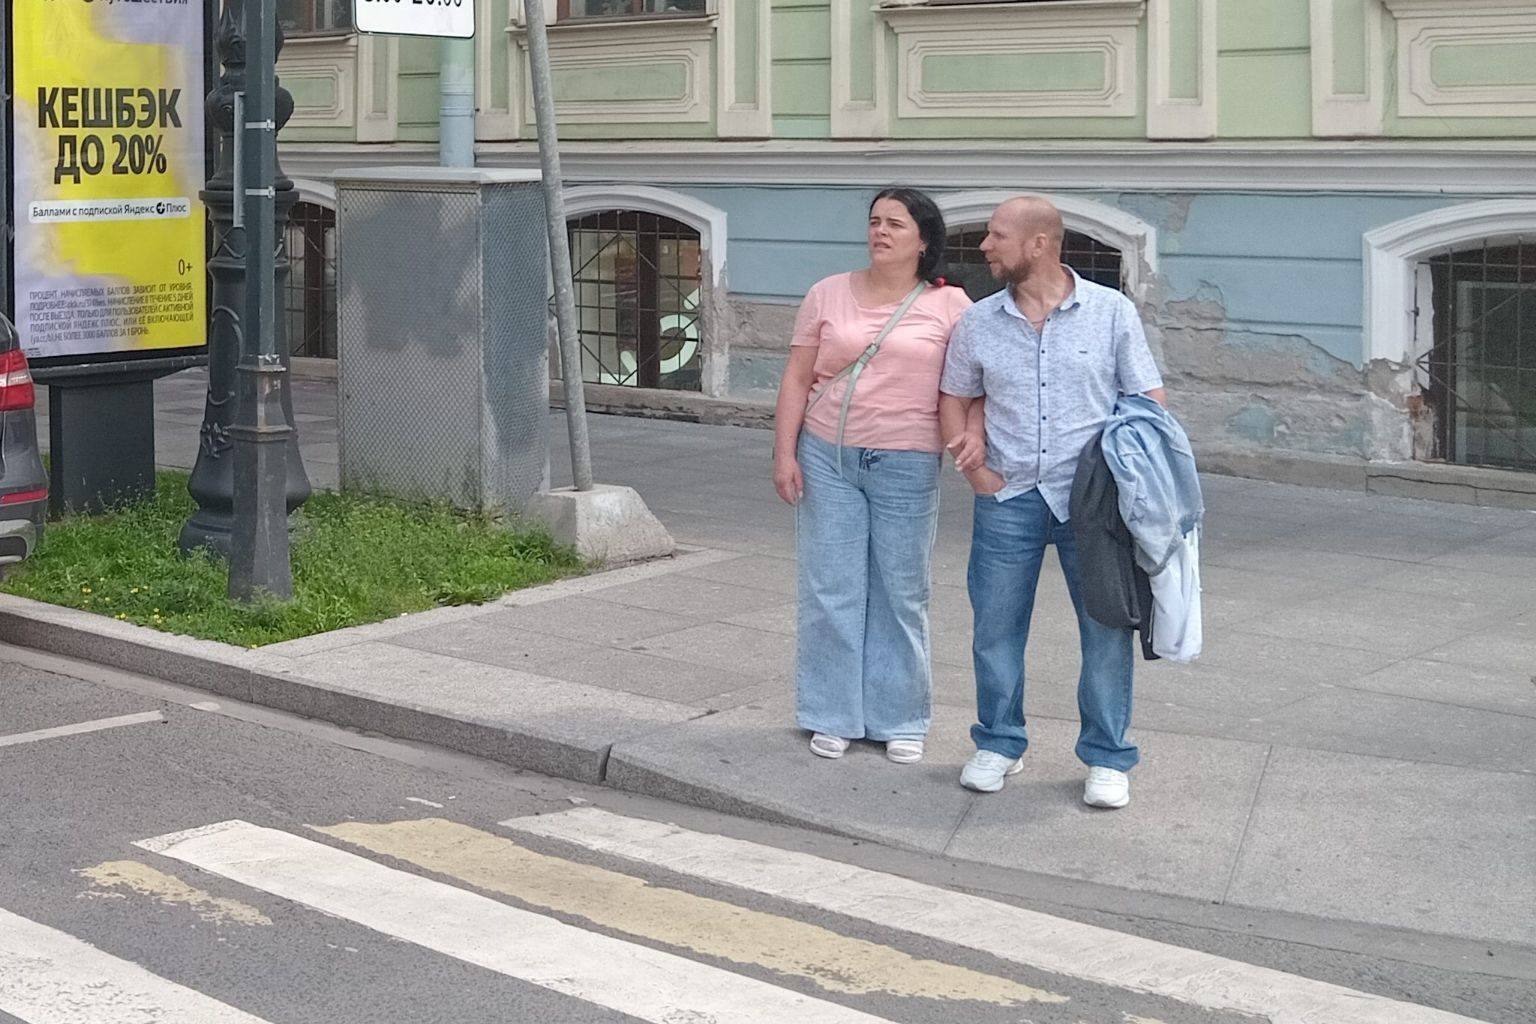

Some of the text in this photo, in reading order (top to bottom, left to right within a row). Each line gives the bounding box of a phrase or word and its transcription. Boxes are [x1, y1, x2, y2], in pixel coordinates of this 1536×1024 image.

[37, 86, 183, 129] КЕШБЭК
[53, 134, 168, 185] ДО 20%
[33, 202, 187, 218] Баллами с подпиской Яндекс Плюс
[178, 258, 193, 276] 0+
